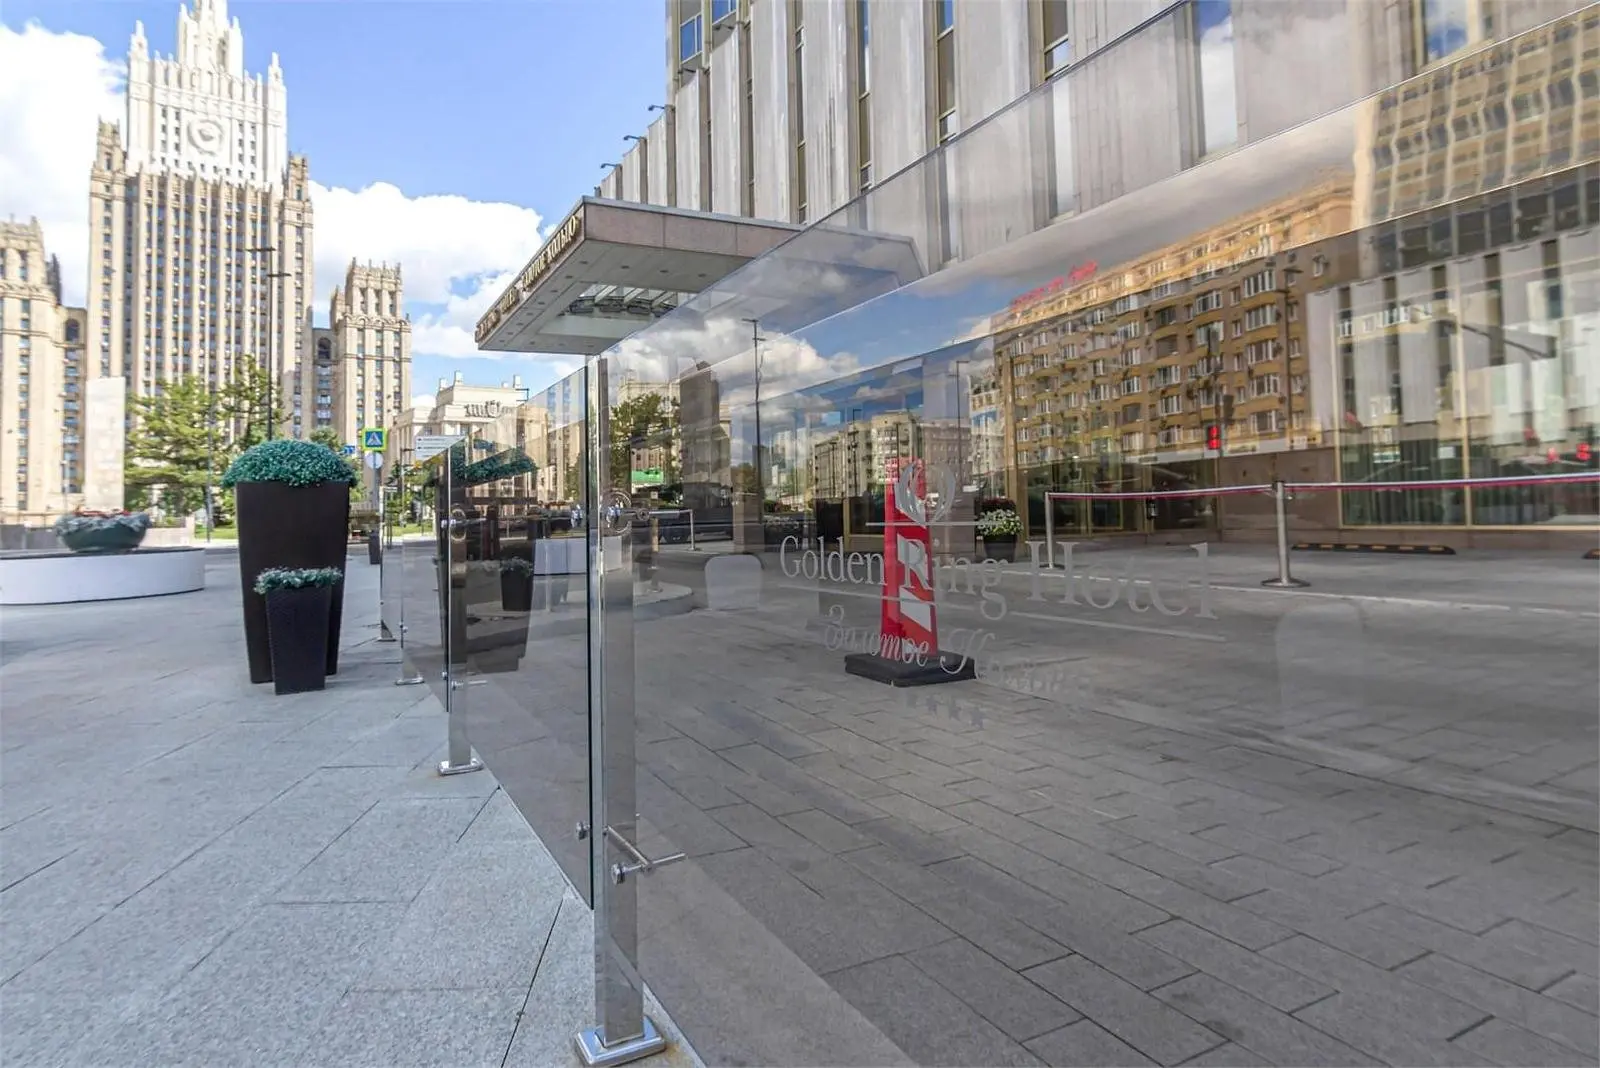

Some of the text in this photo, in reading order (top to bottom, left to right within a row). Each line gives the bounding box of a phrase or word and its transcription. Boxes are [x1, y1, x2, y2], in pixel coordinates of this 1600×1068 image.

[779, 534, 1219, 621] Golden Ring Hotel
